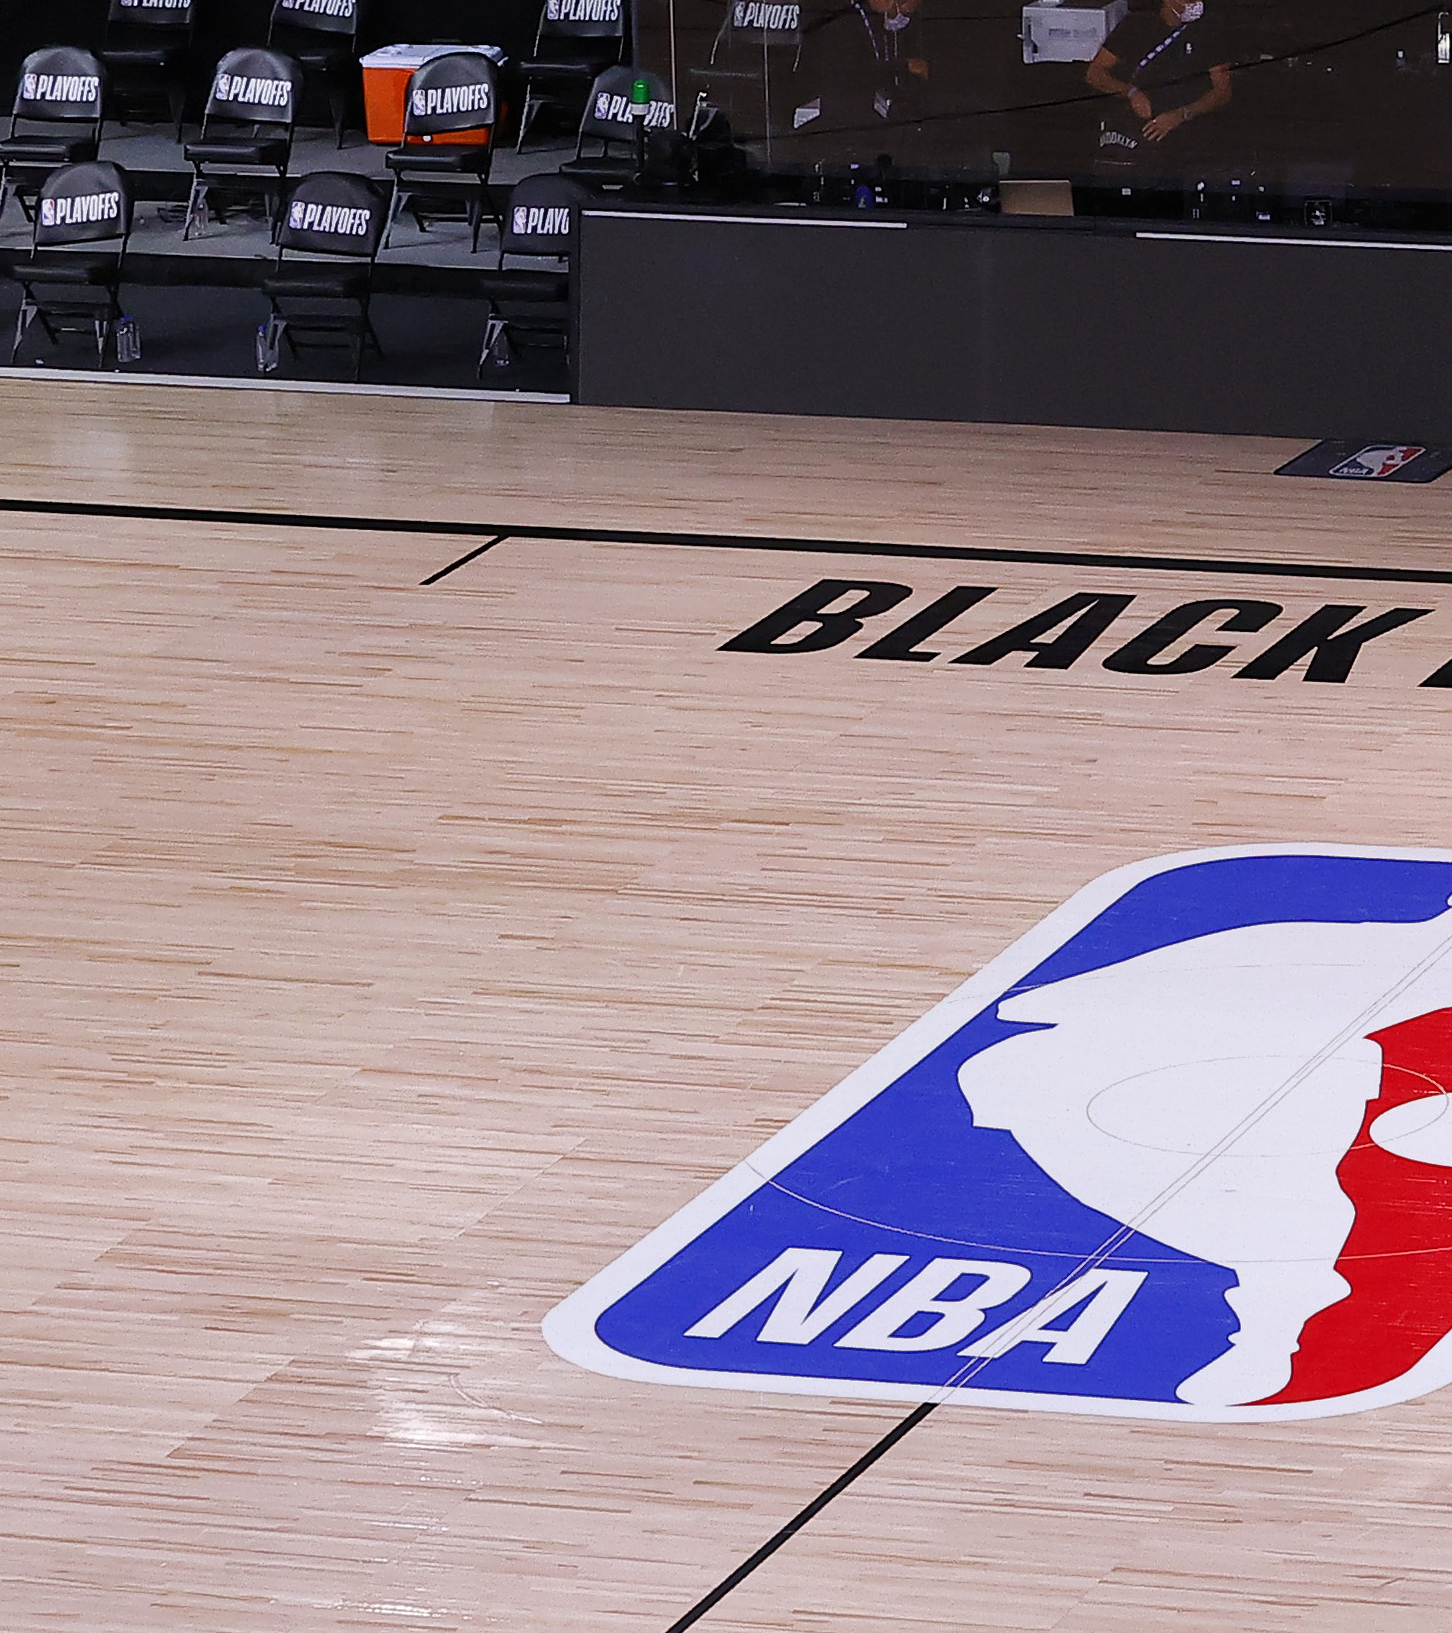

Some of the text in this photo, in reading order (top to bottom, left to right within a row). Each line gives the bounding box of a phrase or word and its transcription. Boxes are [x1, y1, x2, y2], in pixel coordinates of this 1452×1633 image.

[743, 2, 800, 30] PLAYOFFS
[36, 75, 100, 102] PLAYOFFS
[229, 76, 292, 106] PLAYOFFS
[426, 83, 489, 115] PLAYOFFS
[55, 191, 120, 225] PLAYOFFS
[304, 204, 370, 237] PLAYOFFS
[715, 578, 1436, 684] BLACK
[683, 1246, 1149, 1366] NBA
